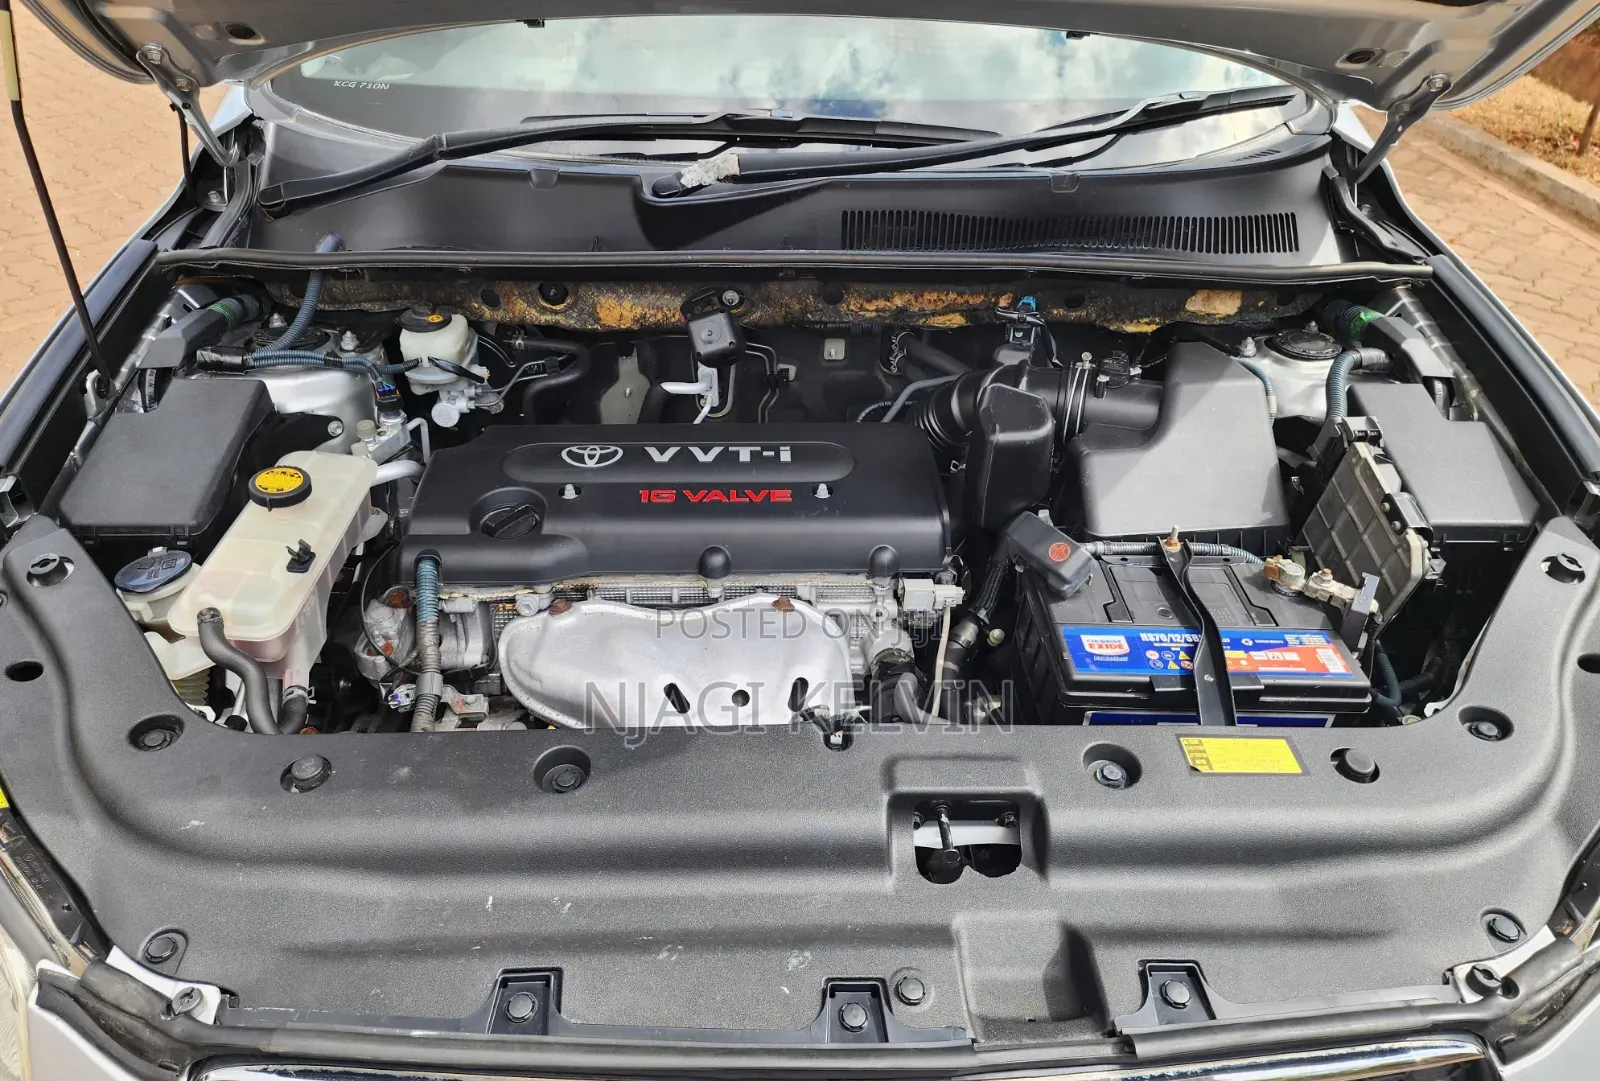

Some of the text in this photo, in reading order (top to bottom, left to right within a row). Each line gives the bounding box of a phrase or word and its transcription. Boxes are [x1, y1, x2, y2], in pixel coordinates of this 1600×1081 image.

[333, 80, 390, 90] KCG 710N
[643, 446, 792, 463] VVT-i
[639, 489, 793, 503] 16 VALVE
